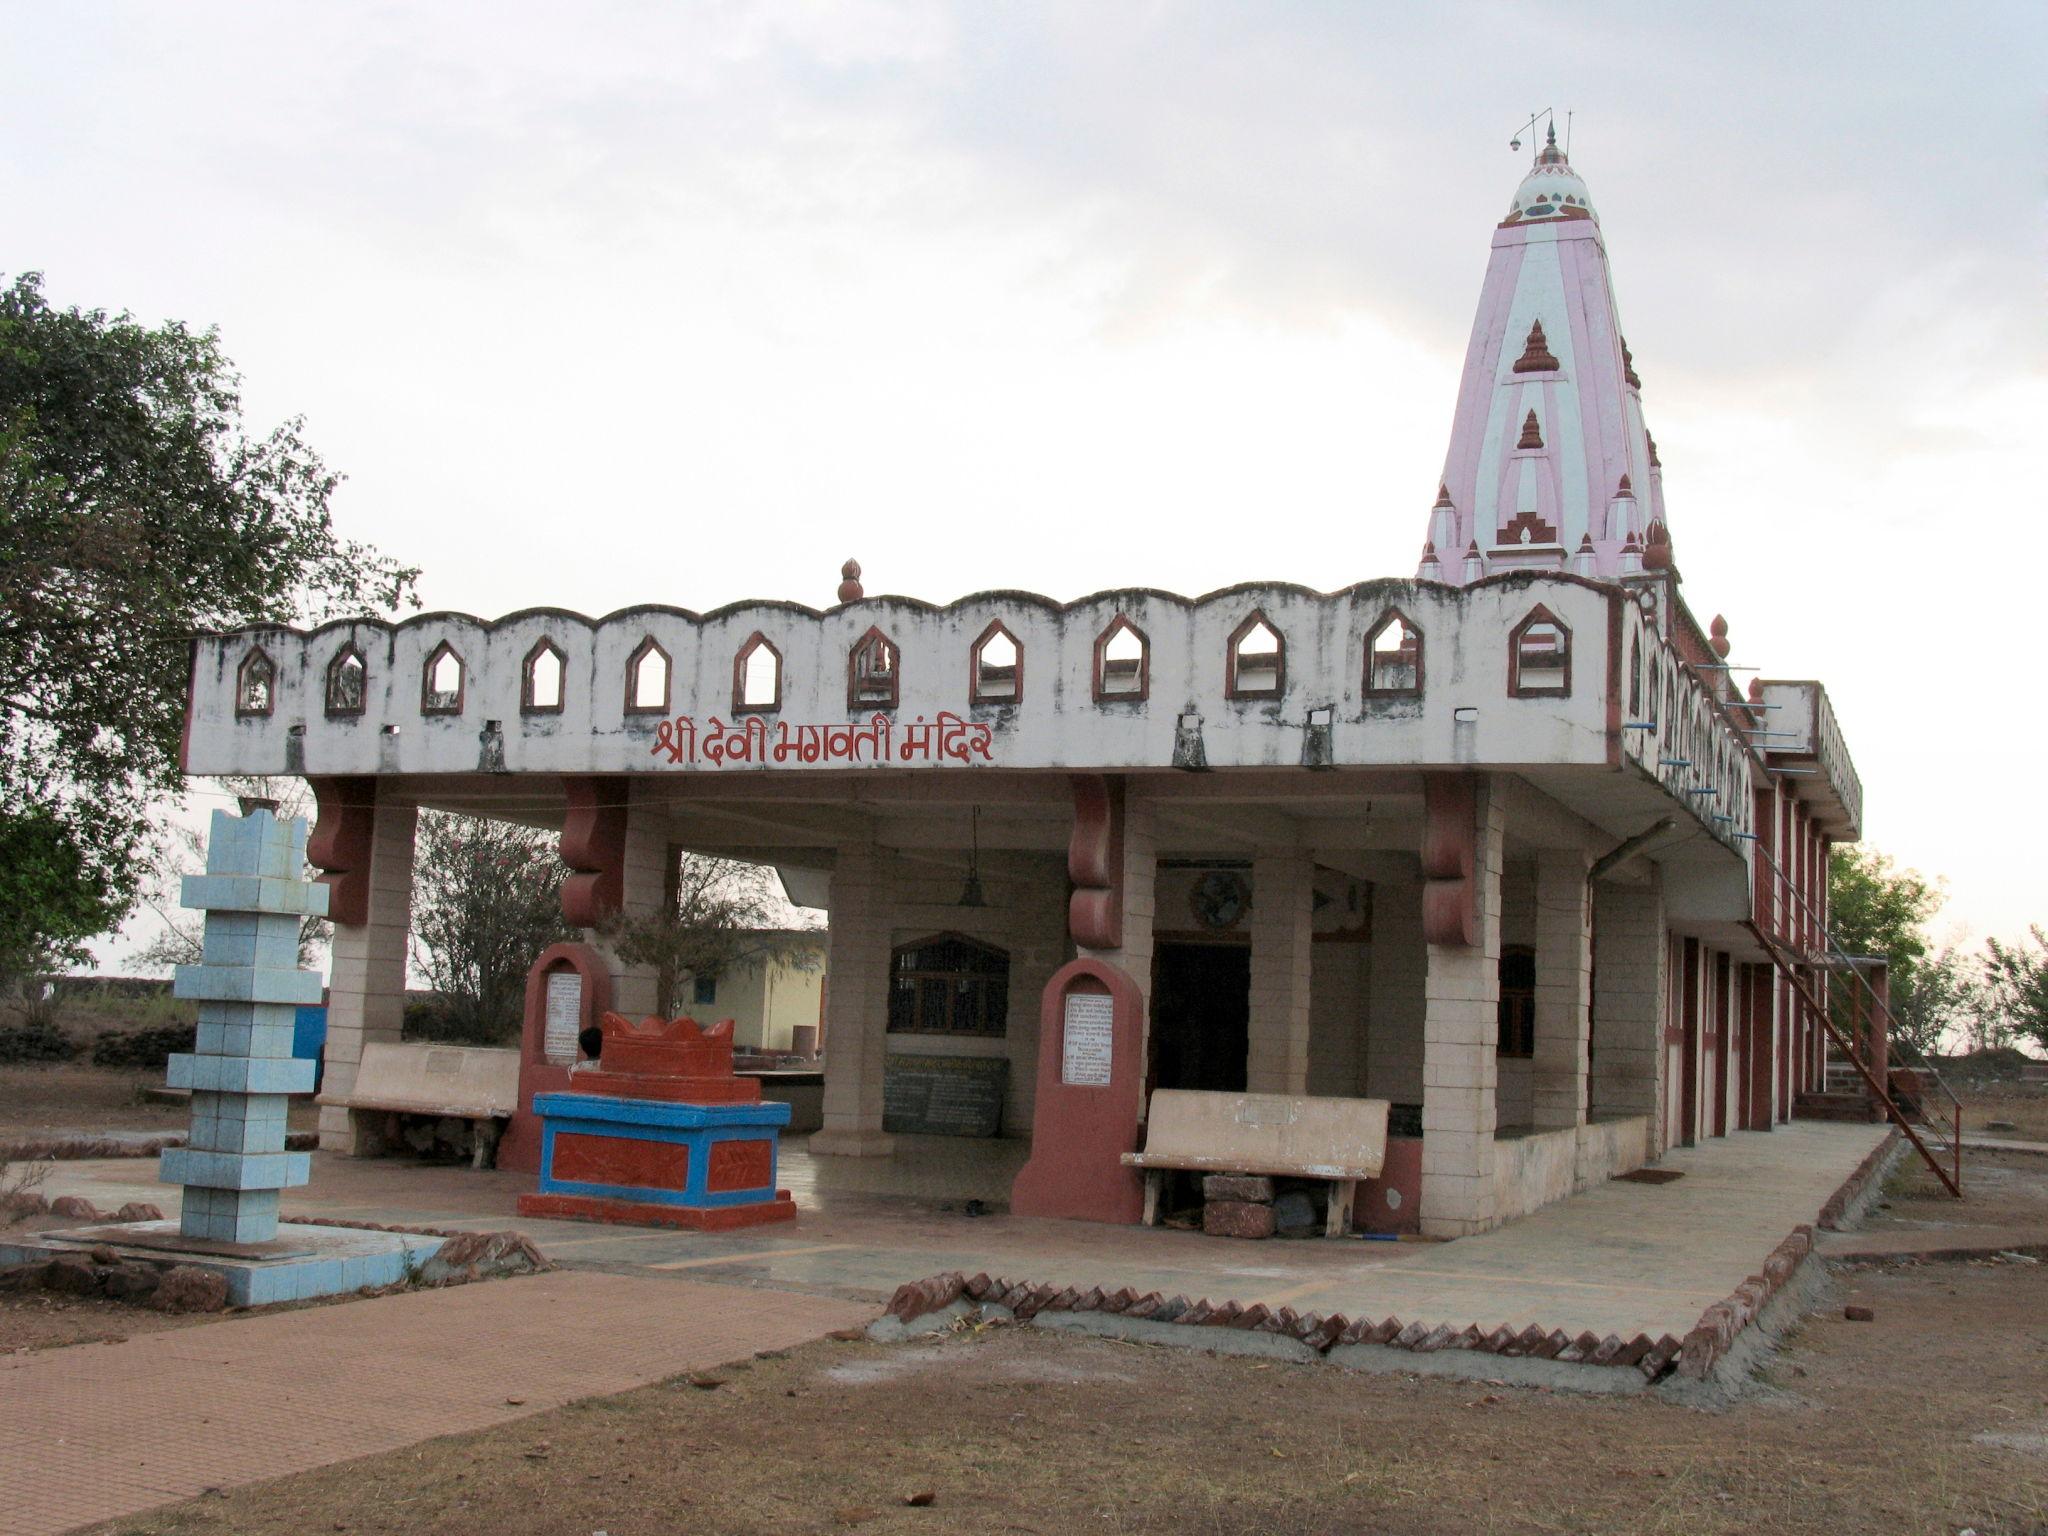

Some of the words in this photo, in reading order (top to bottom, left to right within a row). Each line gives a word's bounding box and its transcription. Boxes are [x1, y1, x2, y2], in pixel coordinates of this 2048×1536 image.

[651, 715, 698, 764] श्री
[702, 716, 768, 767] देवी
[773, 711, 896, 763] भगवती
[900, 711, 993, 763] मंदिर
